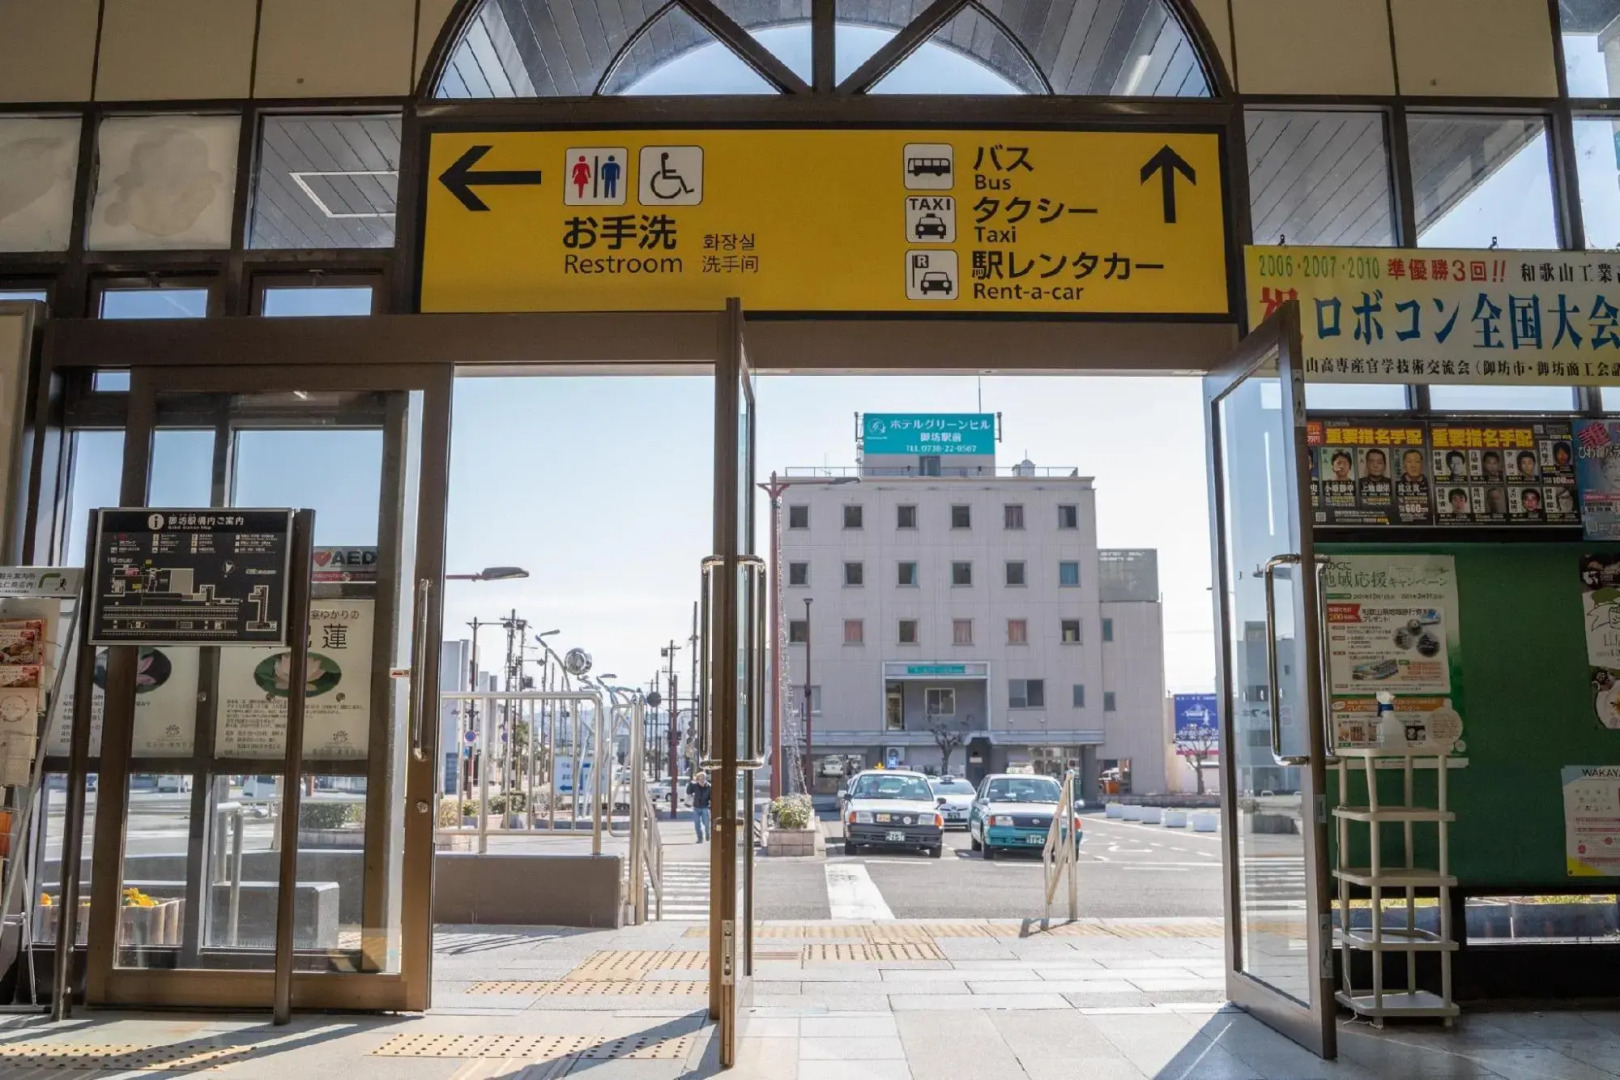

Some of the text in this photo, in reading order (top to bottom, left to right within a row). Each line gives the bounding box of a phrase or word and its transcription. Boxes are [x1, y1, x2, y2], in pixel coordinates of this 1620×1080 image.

[973, 145, 1034, 172] バス
[975, 174, 1011, 190] Bus
[909, 198, 952, 211] TAXI
[972, 197, 1098, 224] タクシー
[562, 214, 677, 250] お手洗
[974, 226, 1017, 243] Taxi
[702, 233, 756, 251] 화장실
[564, 253, 683, 274] Restroom
[701, 255, 759, 274] 洗手间
[971, 250, 1165, 281] 駅レンタカー
[1519, 261, 1620, 285] 和歌山工業
[973, 282, 1084, 300] Rent-a-car
[890, 419, 991, 430] ホテルグリーンヒル
[920, 432, 962, 442] 御坊駅前
[1325, 427, 1423, 445] 重要指名手配
[1432, 428, 1534, 448] 重要指名手配
[168, 516, 244, 526] 御坊駅構内ご案内
[330, 550, 378, 565] AED
[1582, 768, 1620, 778] WAKAY
